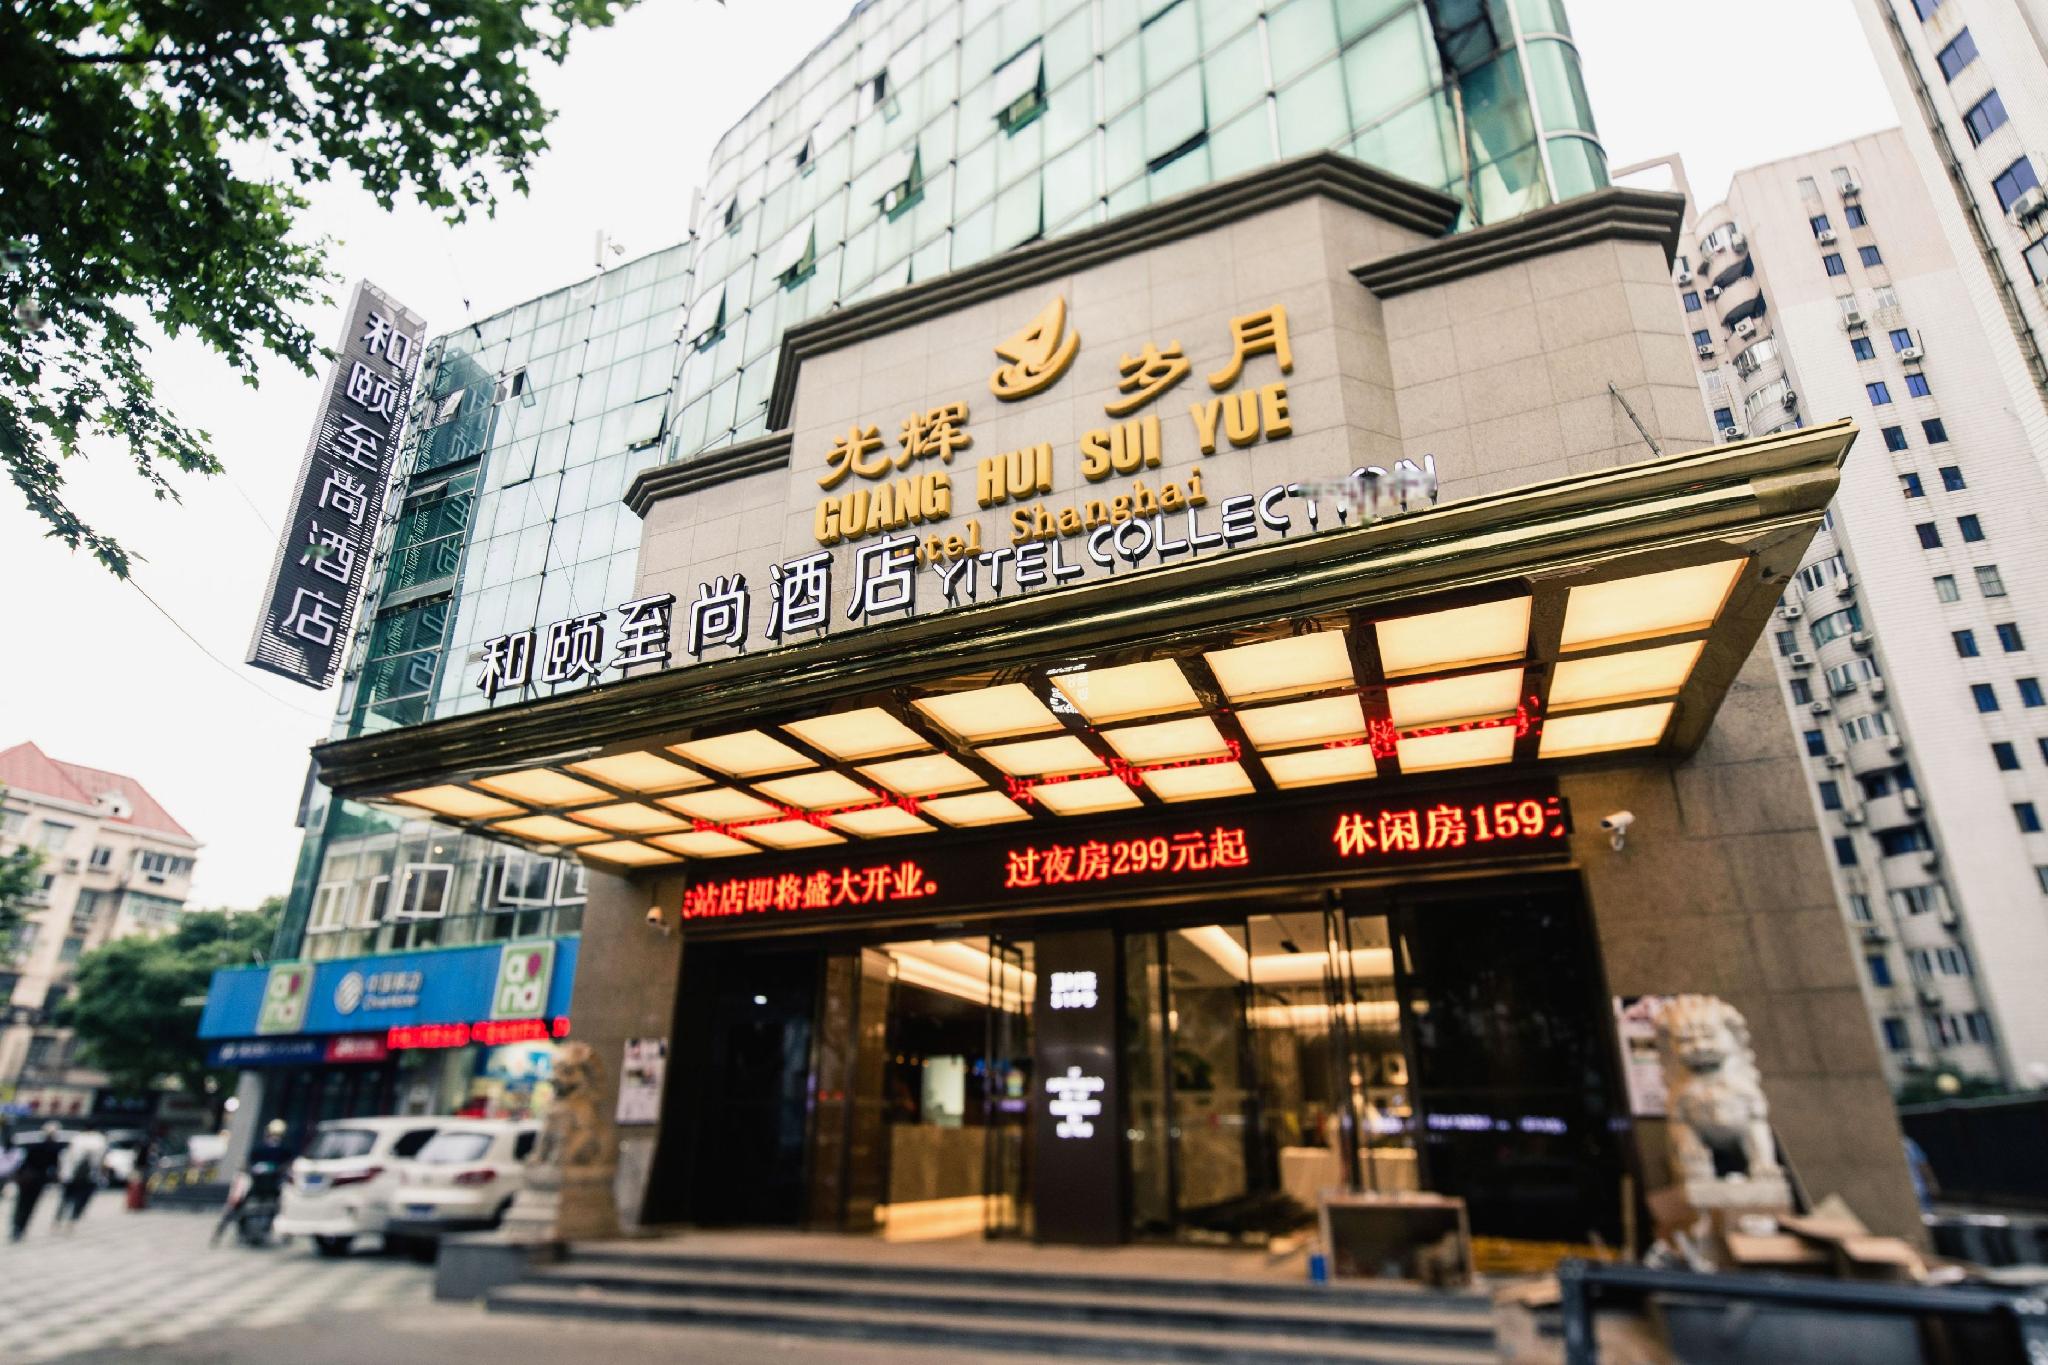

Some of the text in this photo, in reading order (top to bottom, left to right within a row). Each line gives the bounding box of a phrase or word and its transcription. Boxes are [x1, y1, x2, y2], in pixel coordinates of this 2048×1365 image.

[282, 310, 411, 646] 和颐至尚酒店
[814, 382, 1293, 546] GUANG HUI SUI YUE
[815, 303, 1294, 490] 光辉 岁月
[931, 539, 1085, 597] YITEL
[1010, 466, 1208, 546] Shanghai
[477, 534, 920, 699] 和颐至尚酒店
[1004, 826, 1249, 888] 过夜房299元起
